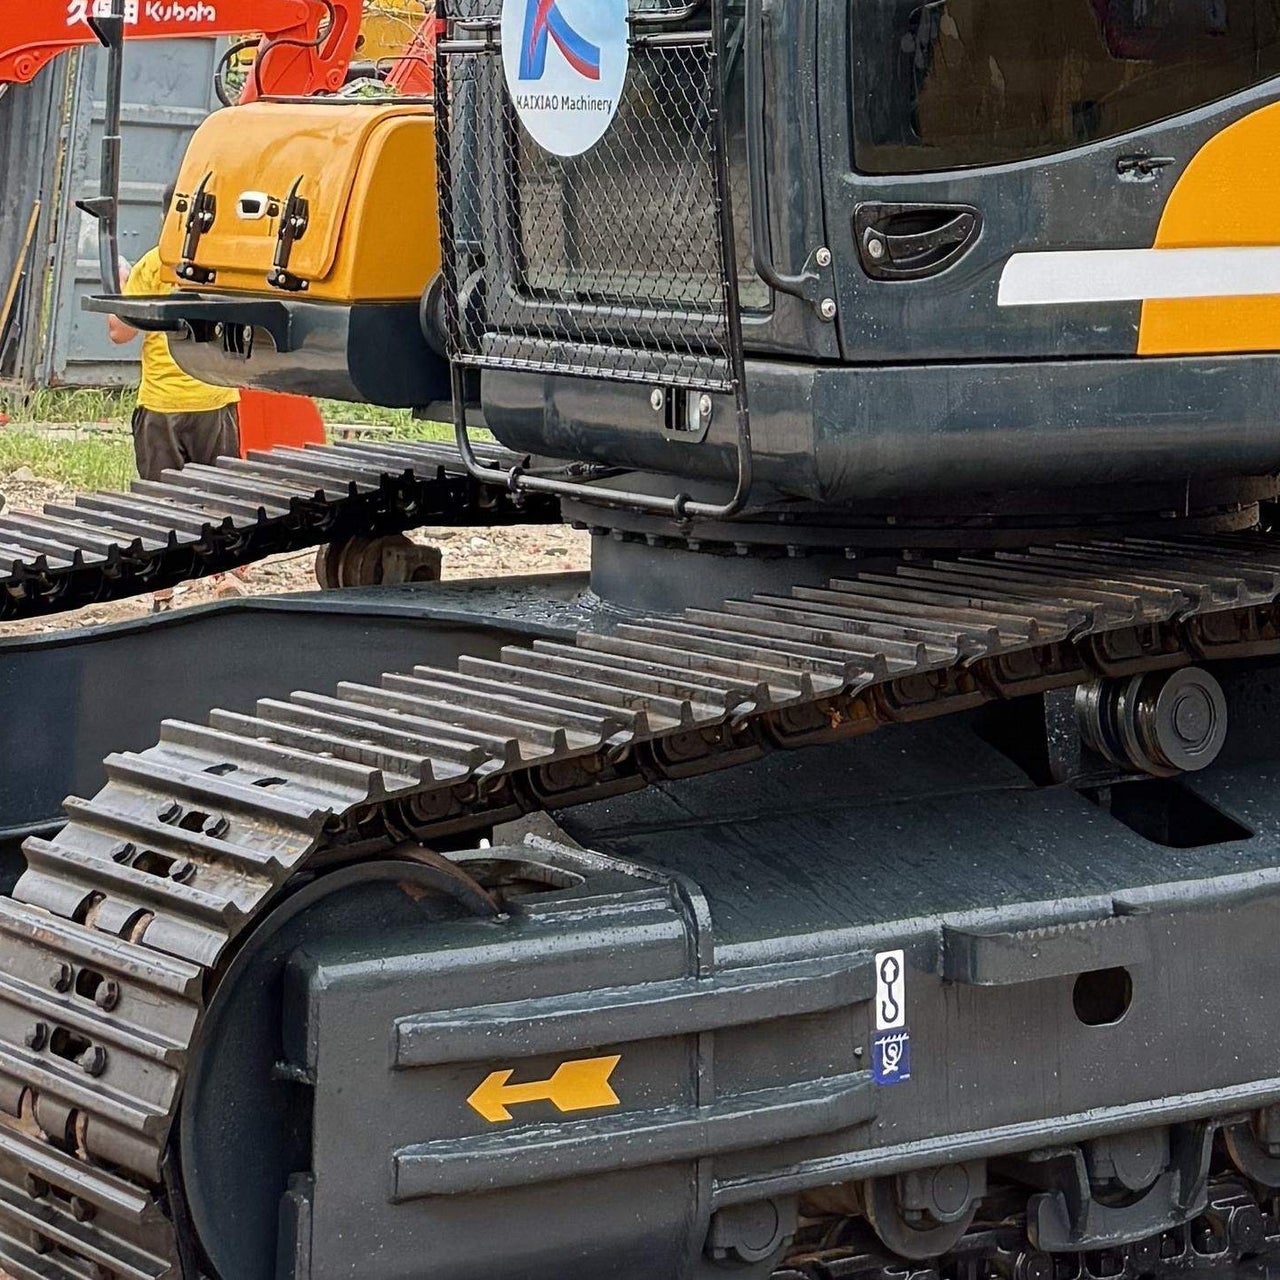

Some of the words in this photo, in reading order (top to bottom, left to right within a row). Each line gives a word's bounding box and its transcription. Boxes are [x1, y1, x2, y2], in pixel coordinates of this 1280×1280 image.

[145, 0, 216, 23] Kubota
[516, 95, 559, 111] KAIXIAO
[561, 94, 613, 115] Machinery
